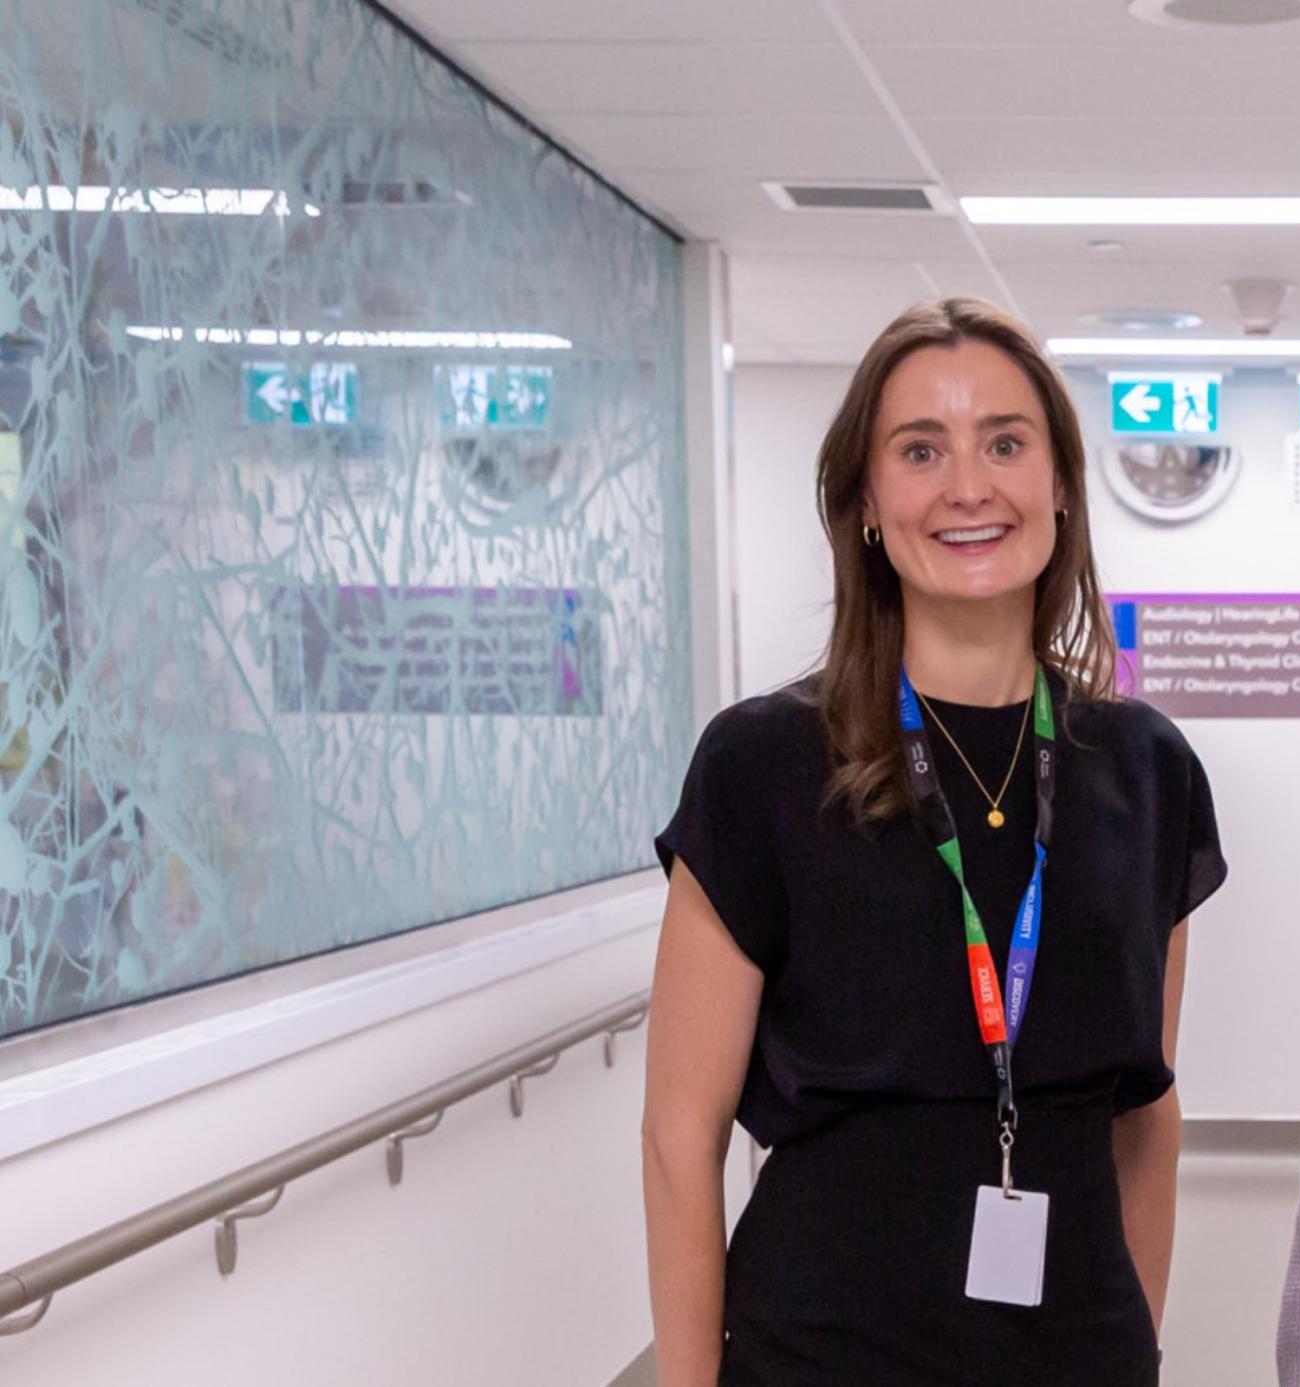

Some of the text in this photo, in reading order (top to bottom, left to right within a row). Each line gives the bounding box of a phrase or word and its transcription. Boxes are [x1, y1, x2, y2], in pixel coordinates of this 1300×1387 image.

[1142, 606, 1213, 625] Audiology
[1223, 606, 1300, 625] HearingLife
[1142, 630, 1172, 645] ENT
[1184, 629, 1290, 648] Otolaryngology
[1142, 653, 1211, 669] Endocrine
[1214, 654, 1226, 669] &
[1229, 653, 1280, 672] Thyroid
[1142, 678, 1172, 693] ENT
[1184, 677, 1290, 696] Otolaryngology
[1010, 977, 1024, 1028] DISCOVERY
